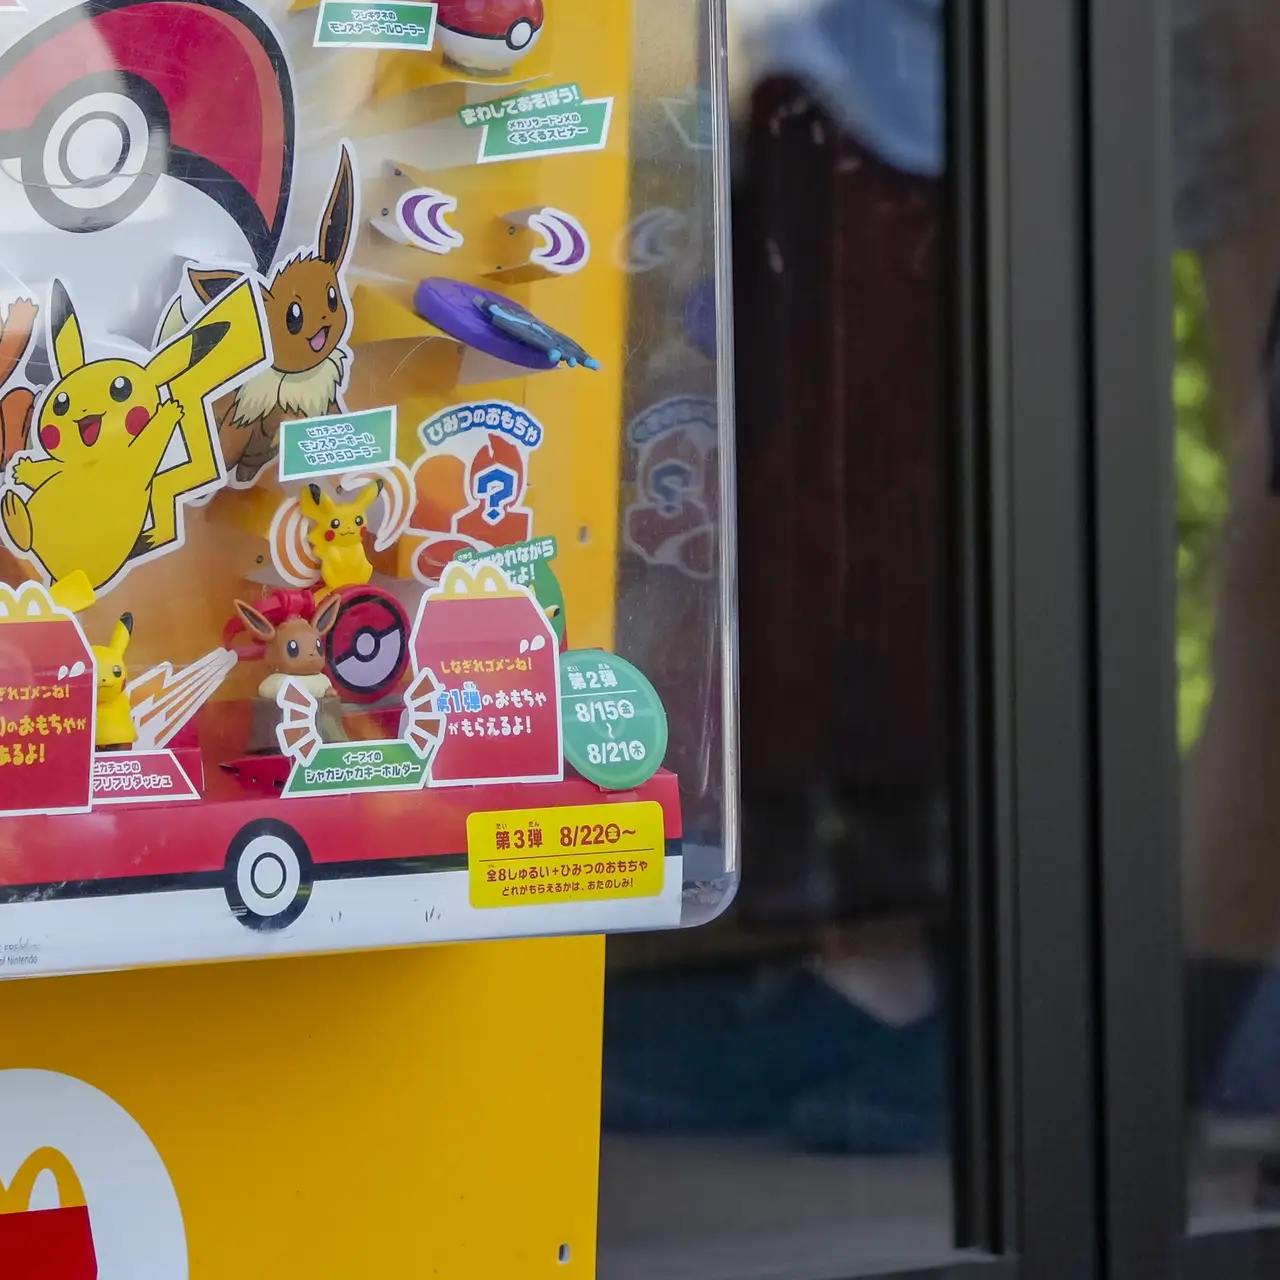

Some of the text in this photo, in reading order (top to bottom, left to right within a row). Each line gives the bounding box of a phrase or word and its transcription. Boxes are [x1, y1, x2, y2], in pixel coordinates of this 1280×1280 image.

[329, 22, 424, 36] モンスターボールローラー
[461, 85, 580, 125] まわしてあそぼう!
[508, 127, 589, 144] くるくるスピナー
[307, 424, 353, 437] ピカチュウの
[427, 403, 540, 446] ひみつのおもちゃ
[299, 433, 375, 451] モンスターボール
[305, 447, 381, 464] ゆらゆらローラー
[441, 657, 532, 674] しなぎれゴメンね!
[568, 669, 618, 690] 第2弾
[448, 715, 532, 737] がもらえるよ!
[343, 751, 382, 763] イーブイの
[306, 763, 420, 782] シャカシャカキーホルダー
[495, 829, 543, 851] 第3弾
[501, 878, 634, 897] どれがもらえるかは、おたのしみ!
